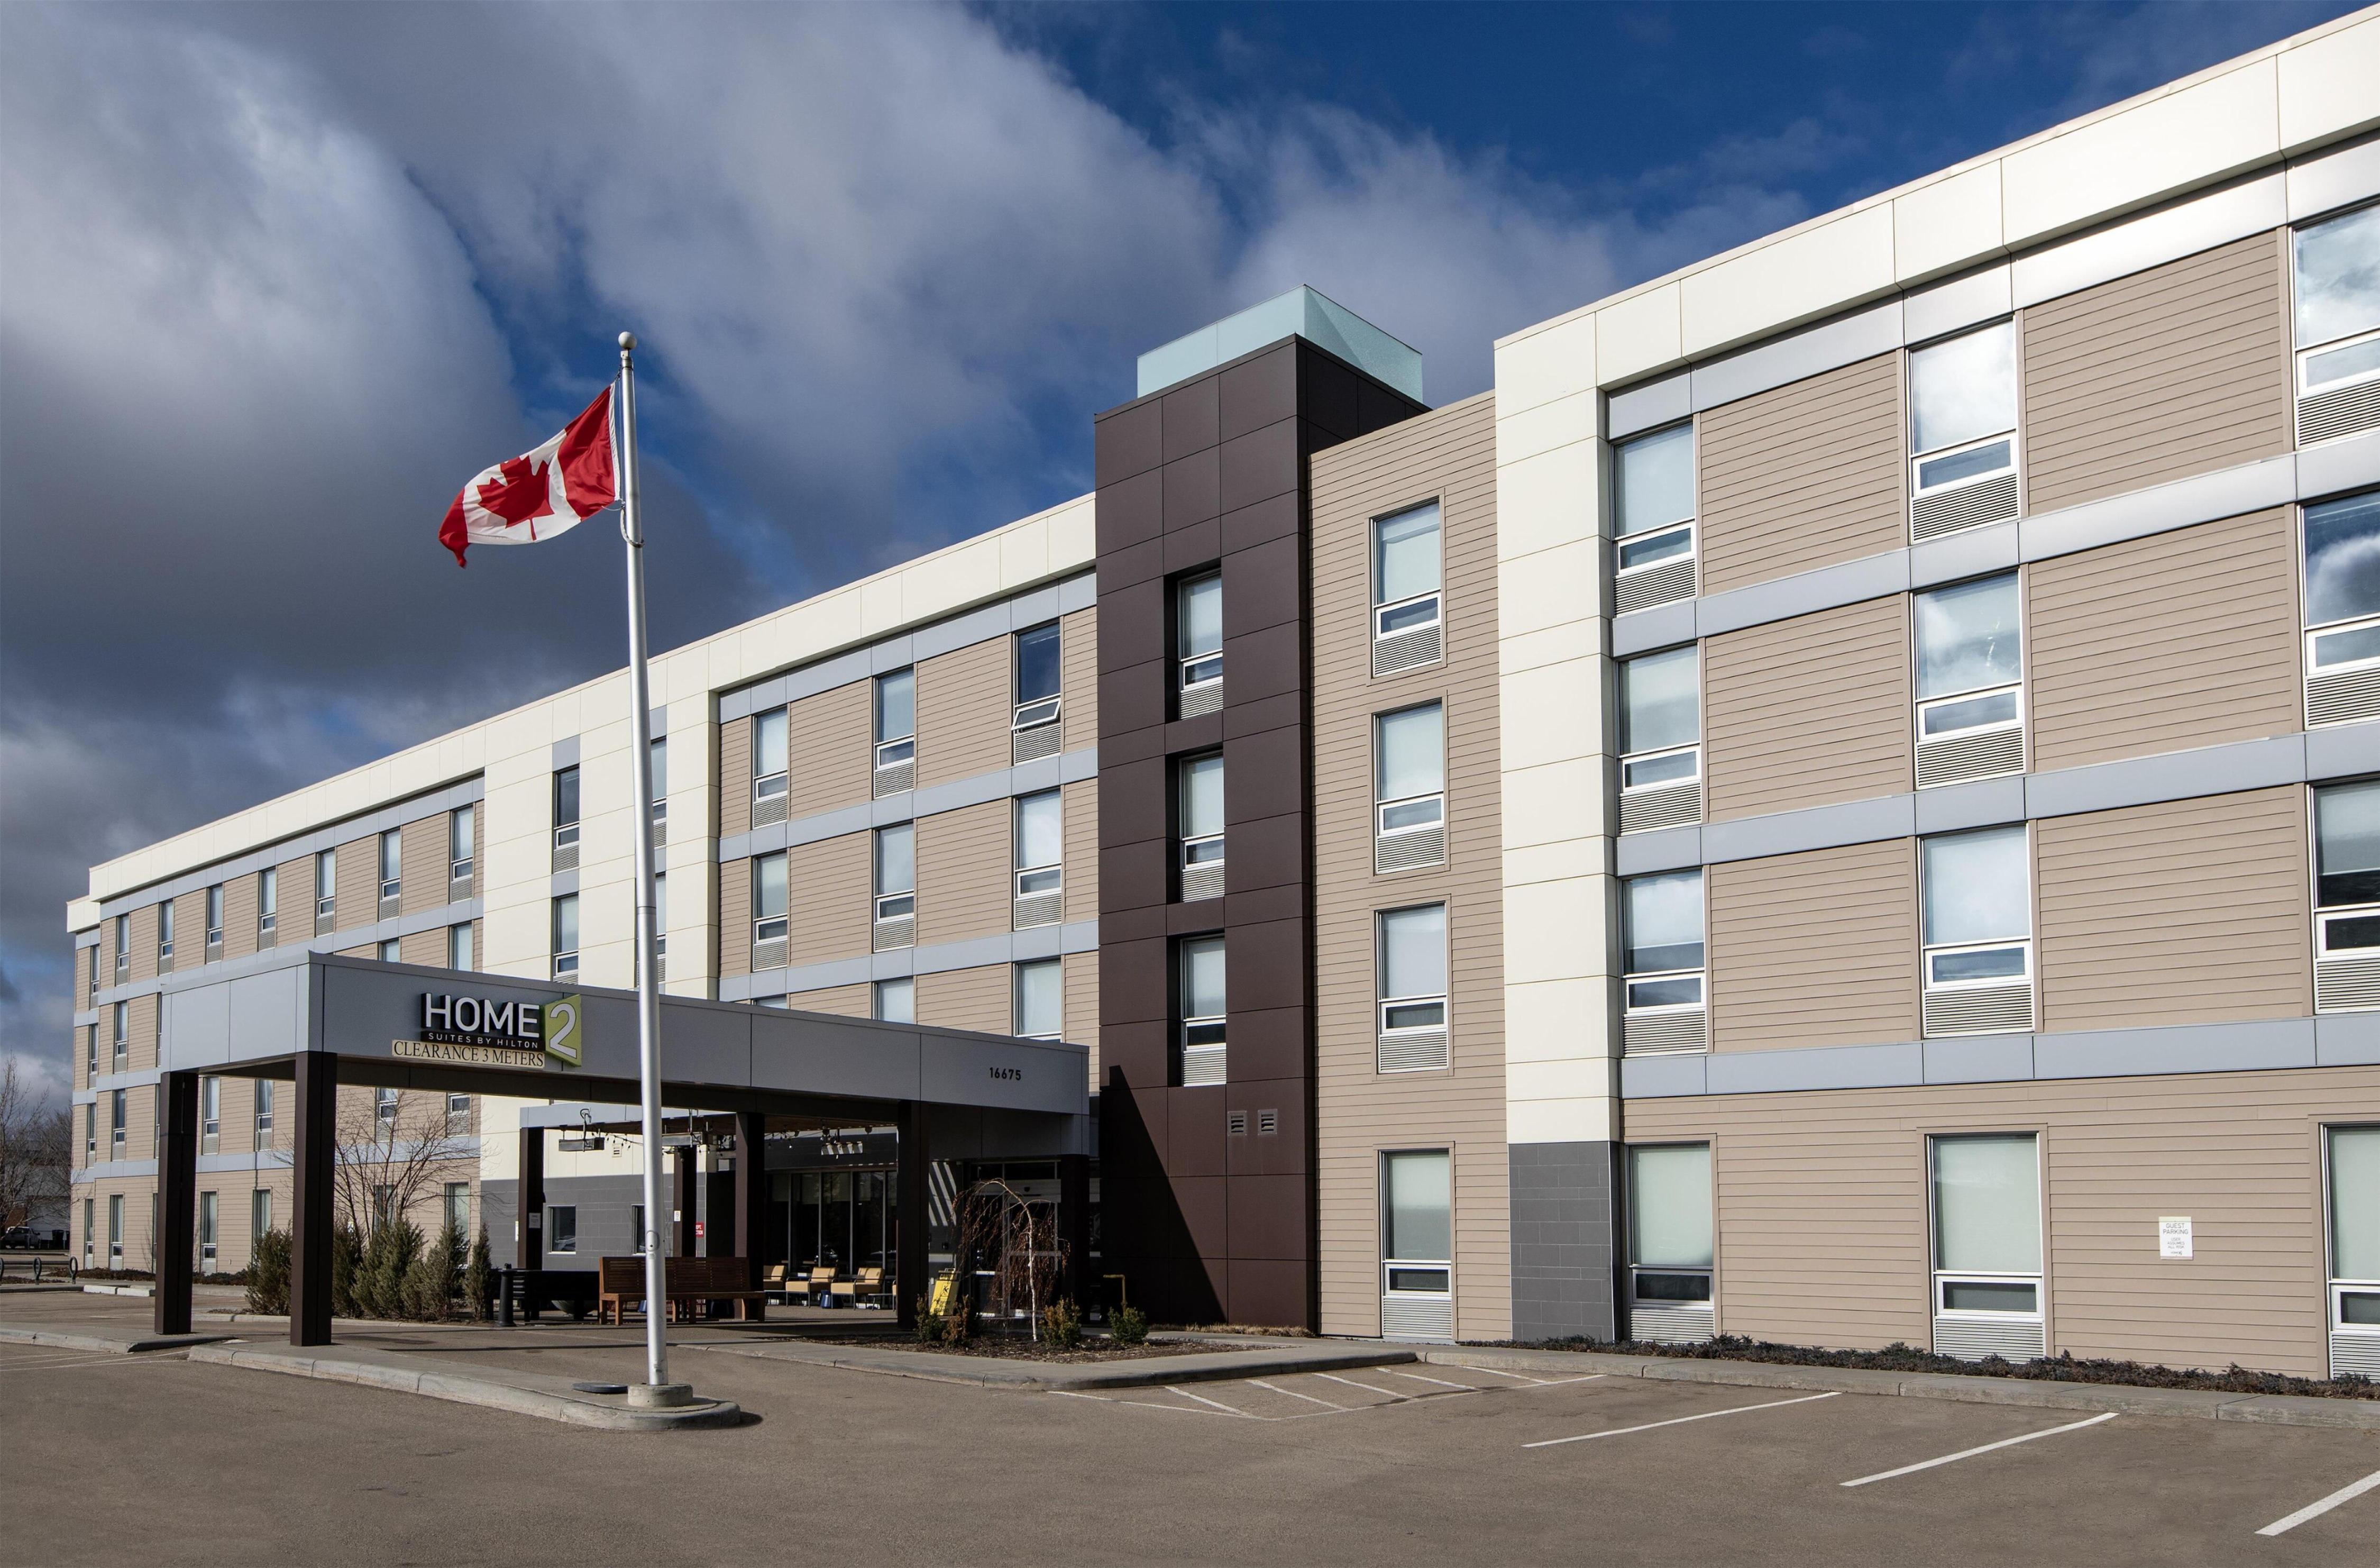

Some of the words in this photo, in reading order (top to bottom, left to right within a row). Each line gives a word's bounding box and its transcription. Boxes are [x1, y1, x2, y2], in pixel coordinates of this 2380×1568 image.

[425, 992, 539, 1038] HOME
[548, 1002, 578, 1059] 2
[428, 1032, 471, 1043] SUITES
[497, 1038, 538, 1049] HILTON
[394, 1041, 479, 1062] CLEARANCE
[482, 1049, 489, 1062] 3
[492, 1049, 543, 1066] METERS
[990, 1067, 1021, 1080] 16675
